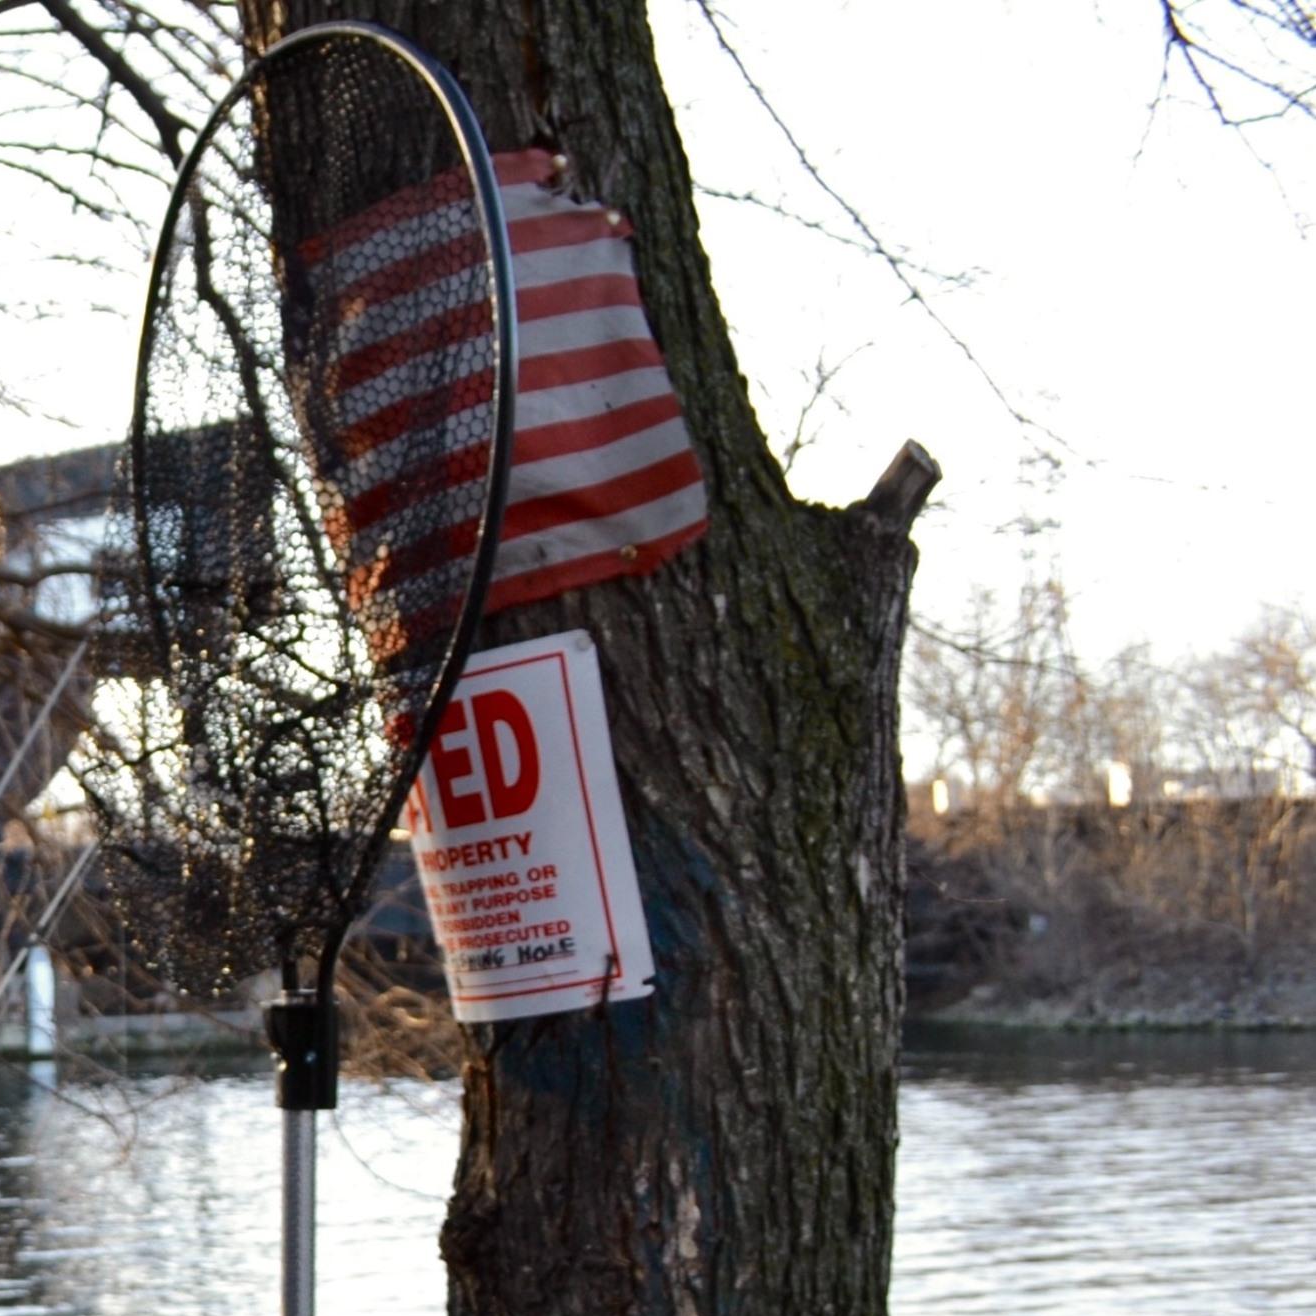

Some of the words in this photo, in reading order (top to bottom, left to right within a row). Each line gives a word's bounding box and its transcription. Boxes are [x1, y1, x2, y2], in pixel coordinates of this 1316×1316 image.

[527, 864, 558, 883] OR
[472, 884, 556, 911] PURPOSE
[518, 936, 576, 965] HOLE
